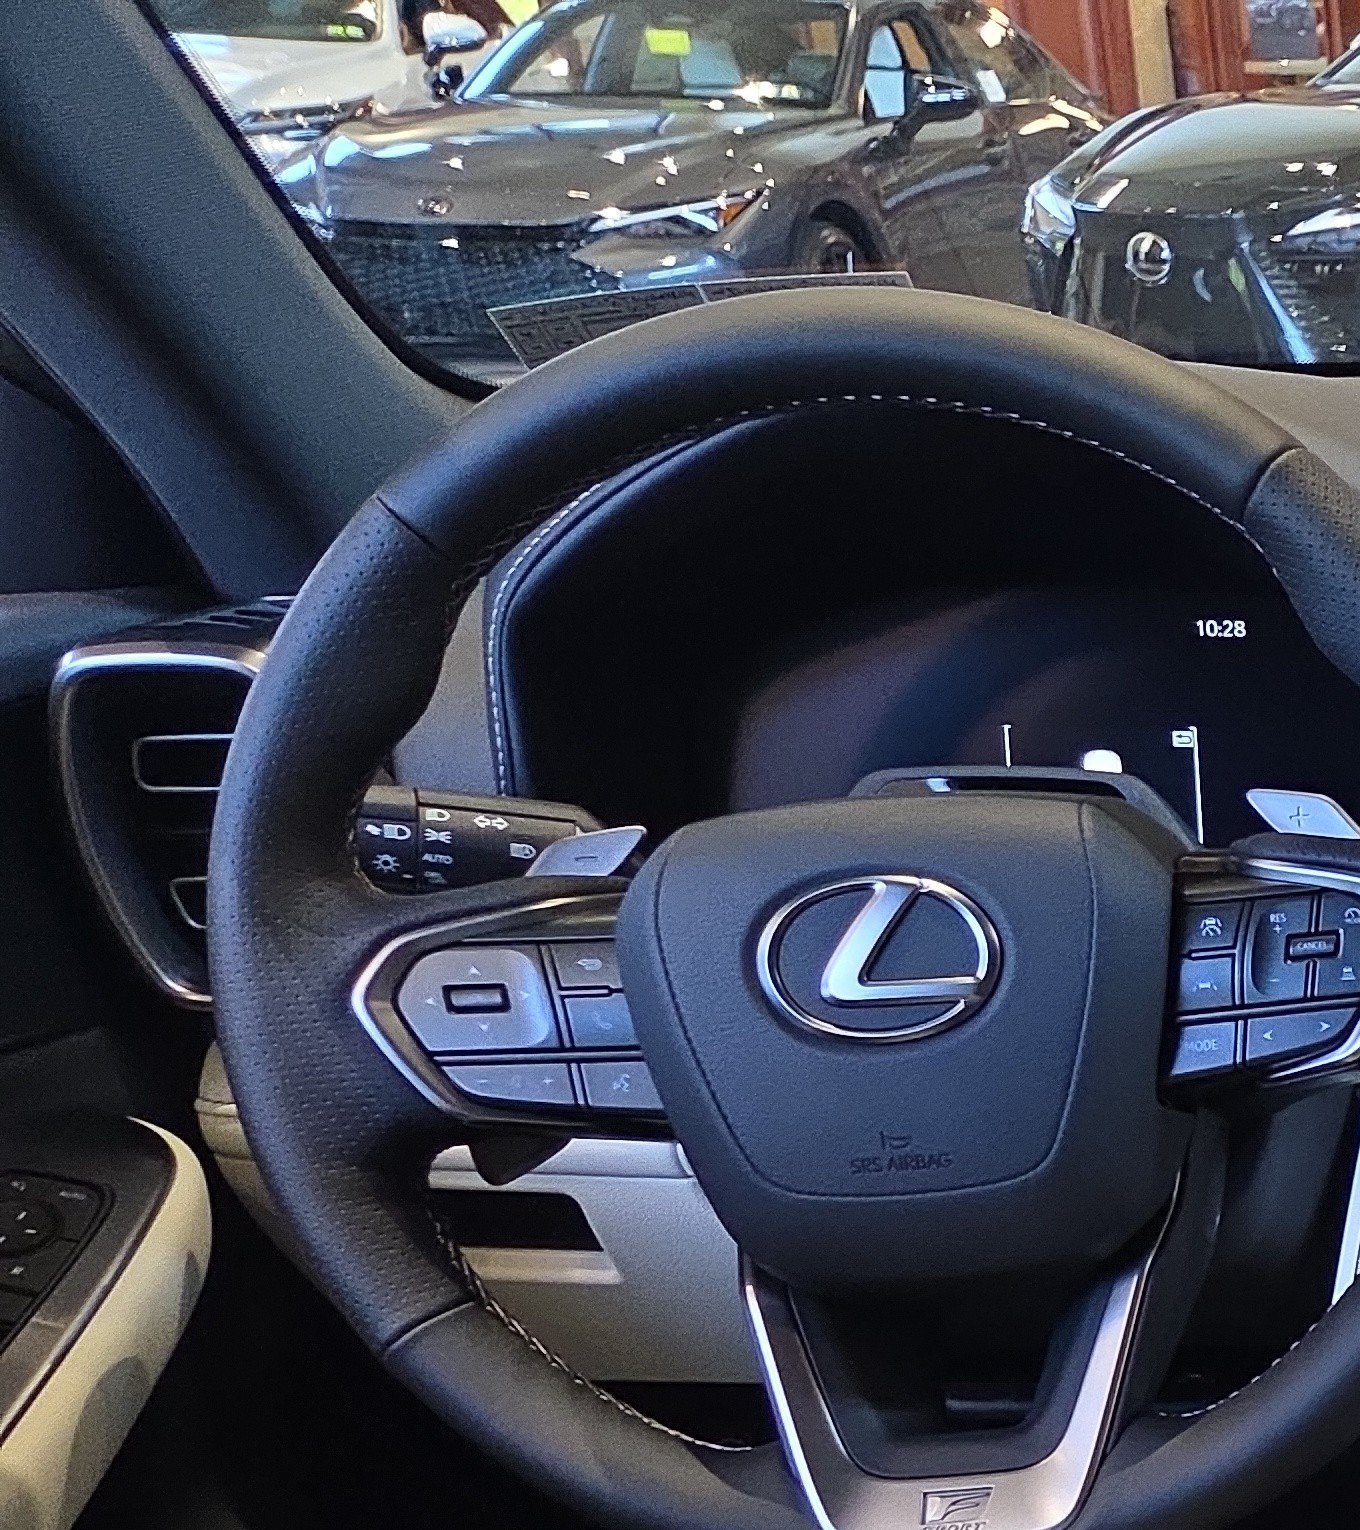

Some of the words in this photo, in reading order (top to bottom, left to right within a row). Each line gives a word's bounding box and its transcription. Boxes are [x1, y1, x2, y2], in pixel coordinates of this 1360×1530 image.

[1196, 619, 1247, 638] 10:28
[850, 1156, 883, 1174] SRS
[887, 1152, 954, 1171] AIRBAG
